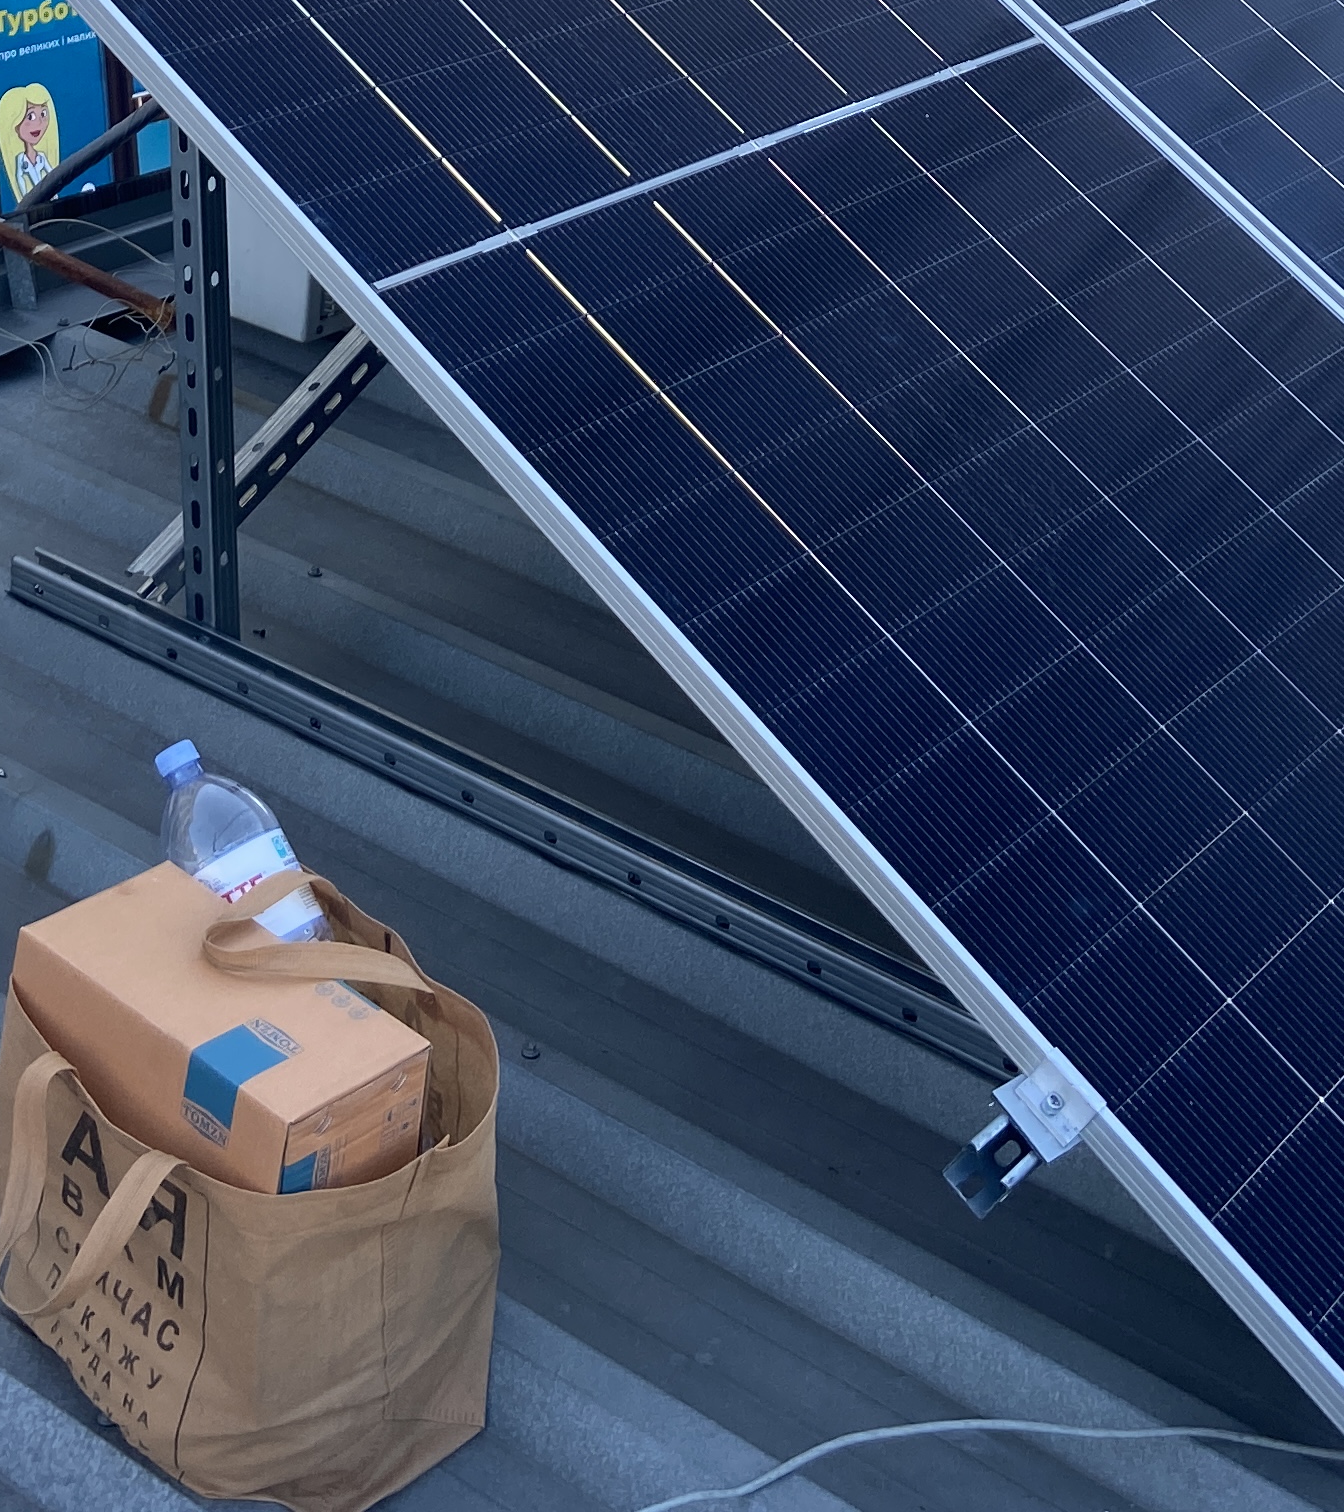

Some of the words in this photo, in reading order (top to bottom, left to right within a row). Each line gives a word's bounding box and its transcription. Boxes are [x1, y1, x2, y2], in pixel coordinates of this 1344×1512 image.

[18, 37, 61, 57] великих
[66, 30, 96, 45] малих
[182, 1104, 228, 1147] TOMZN
